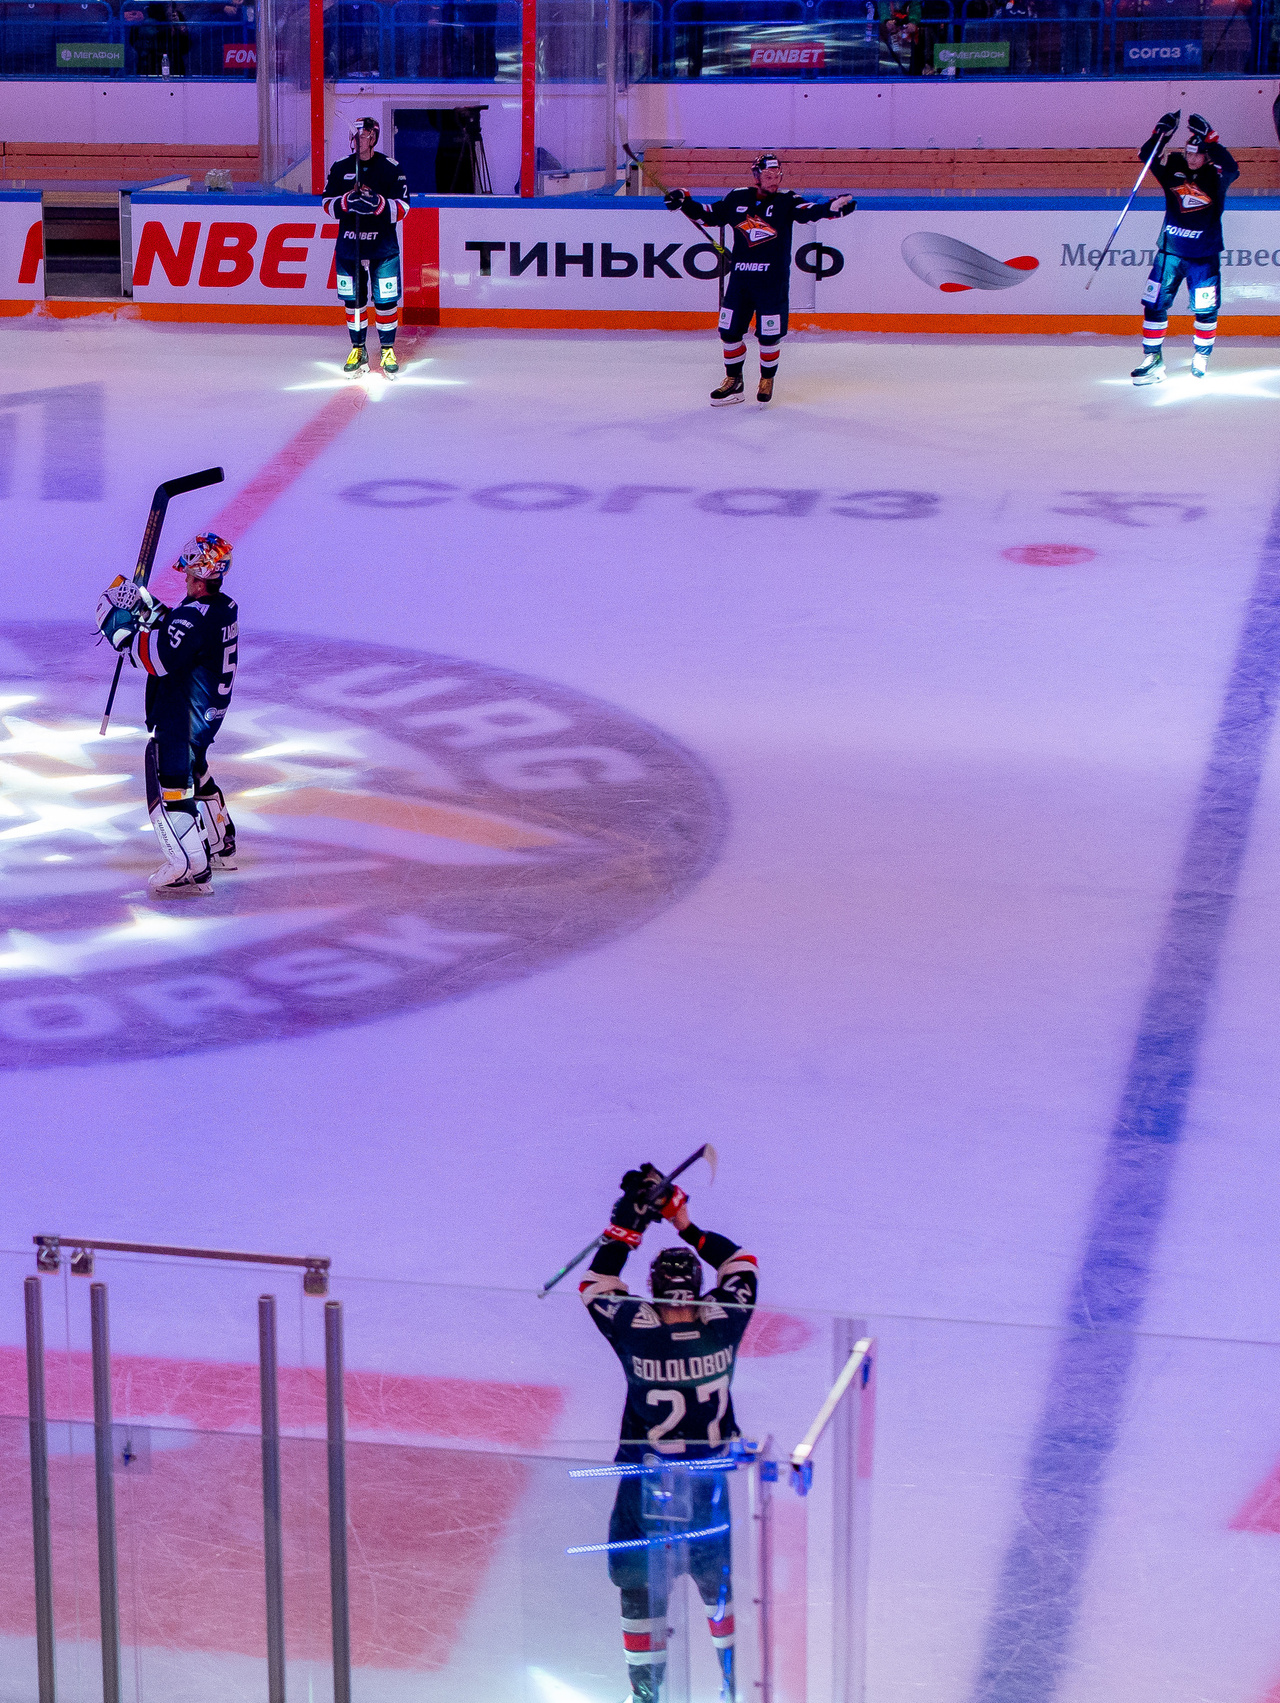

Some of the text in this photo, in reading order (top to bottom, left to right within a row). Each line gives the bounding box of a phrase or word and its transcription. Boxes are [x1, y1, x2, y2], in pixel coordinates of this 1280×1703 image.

[225, 49, 257, 63] FON
[751, 49, 822, 63] FONBET
[1164, 224, 1204, 239] FONBET
[465, 240, 845, 282] ТИНЬКОФ
[734, 262, 771, 272] FONBET
[217, 643, 238, 696] 5
[631, 1344, 734, 1382] GOLOLOBOV
[645, 1373, 729, 1455] 27
